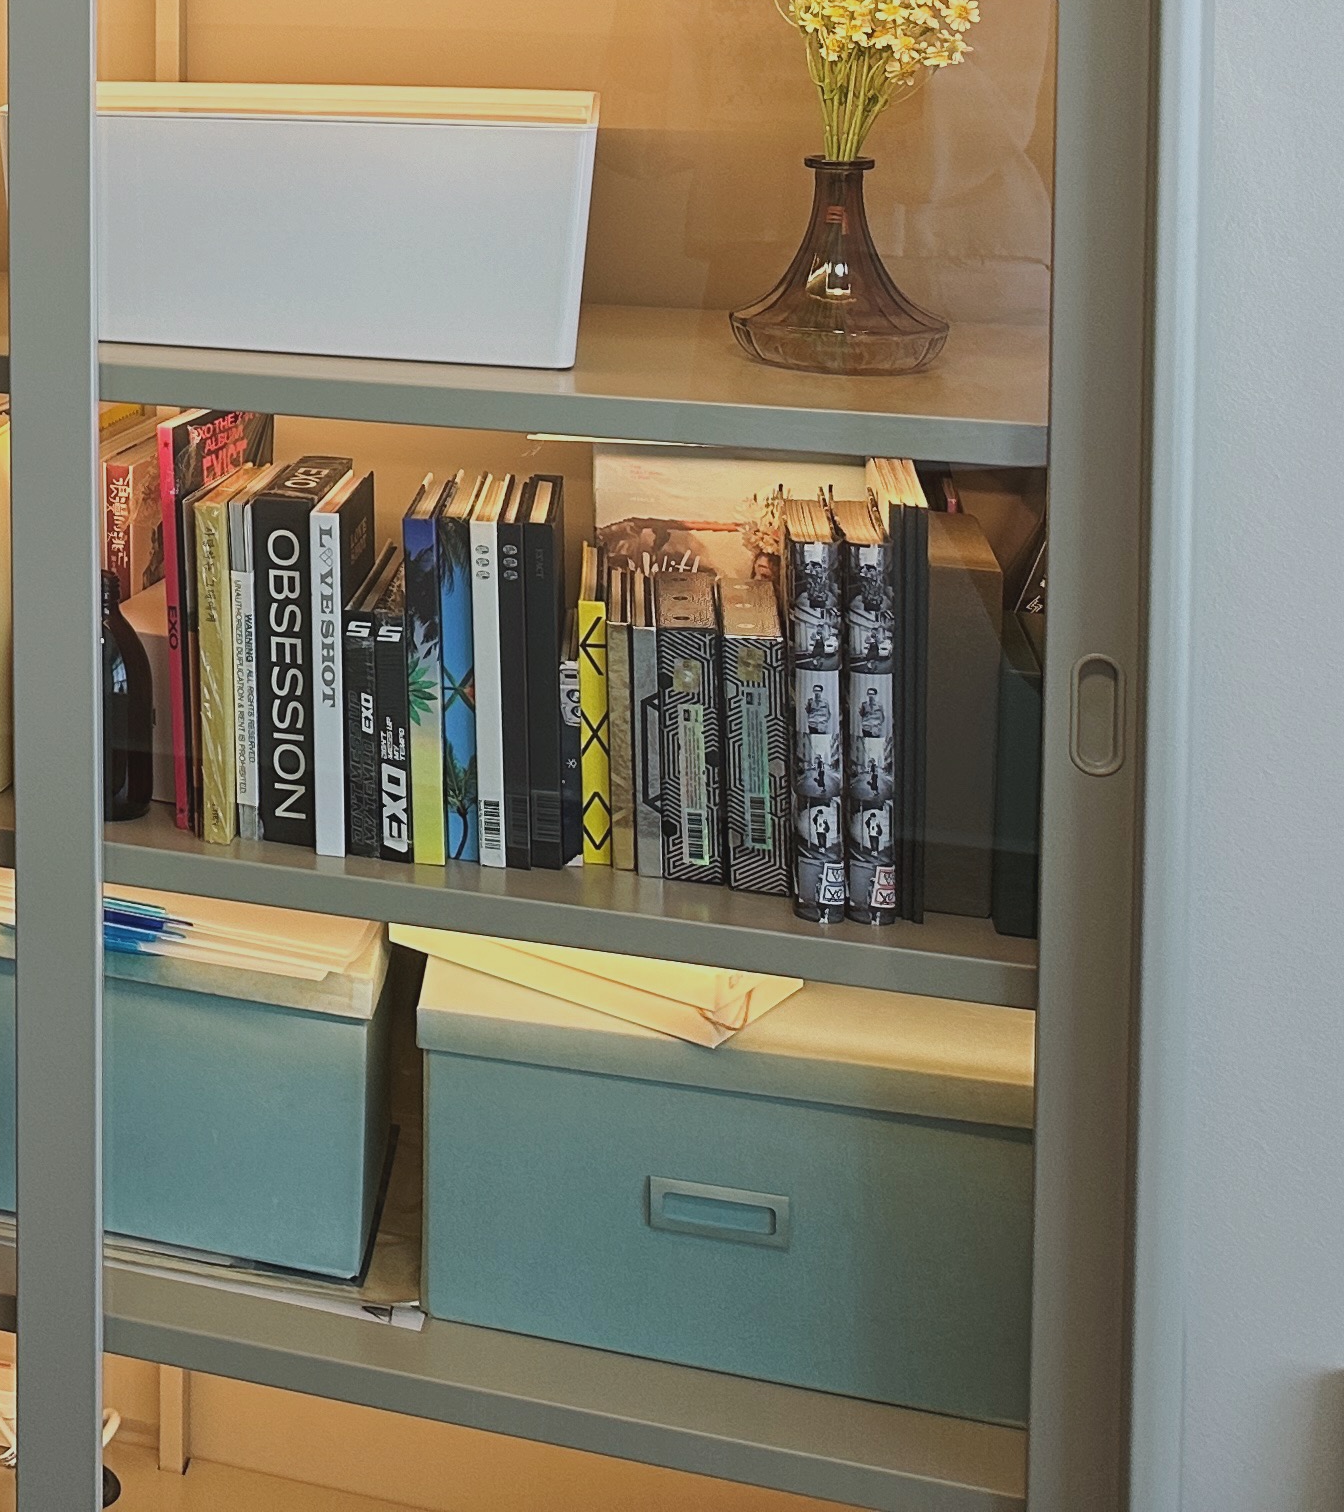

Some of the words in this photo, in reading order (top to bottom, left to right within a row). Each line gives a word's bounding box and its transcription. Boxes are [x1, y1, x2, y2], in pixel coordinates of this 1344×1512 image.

[284, 467, 330, 488] EXO
[168, 605, 178, 650] EXO
[234, 580, 243, 645] UNAUTHORIZED
[245, 614, 253, 662] WARNING
[236, 647, 245, 700] DUPLICATION
[246, 669, 254, 683] ALL
[267, 529, 306, 820] OBSESSION
[321, 619, 336, 708] SHOT
[247, 685, 255, 717] RIGHTS
[361, 692, 374, 735] EXO
[381, 762, 408, 852] EXO
